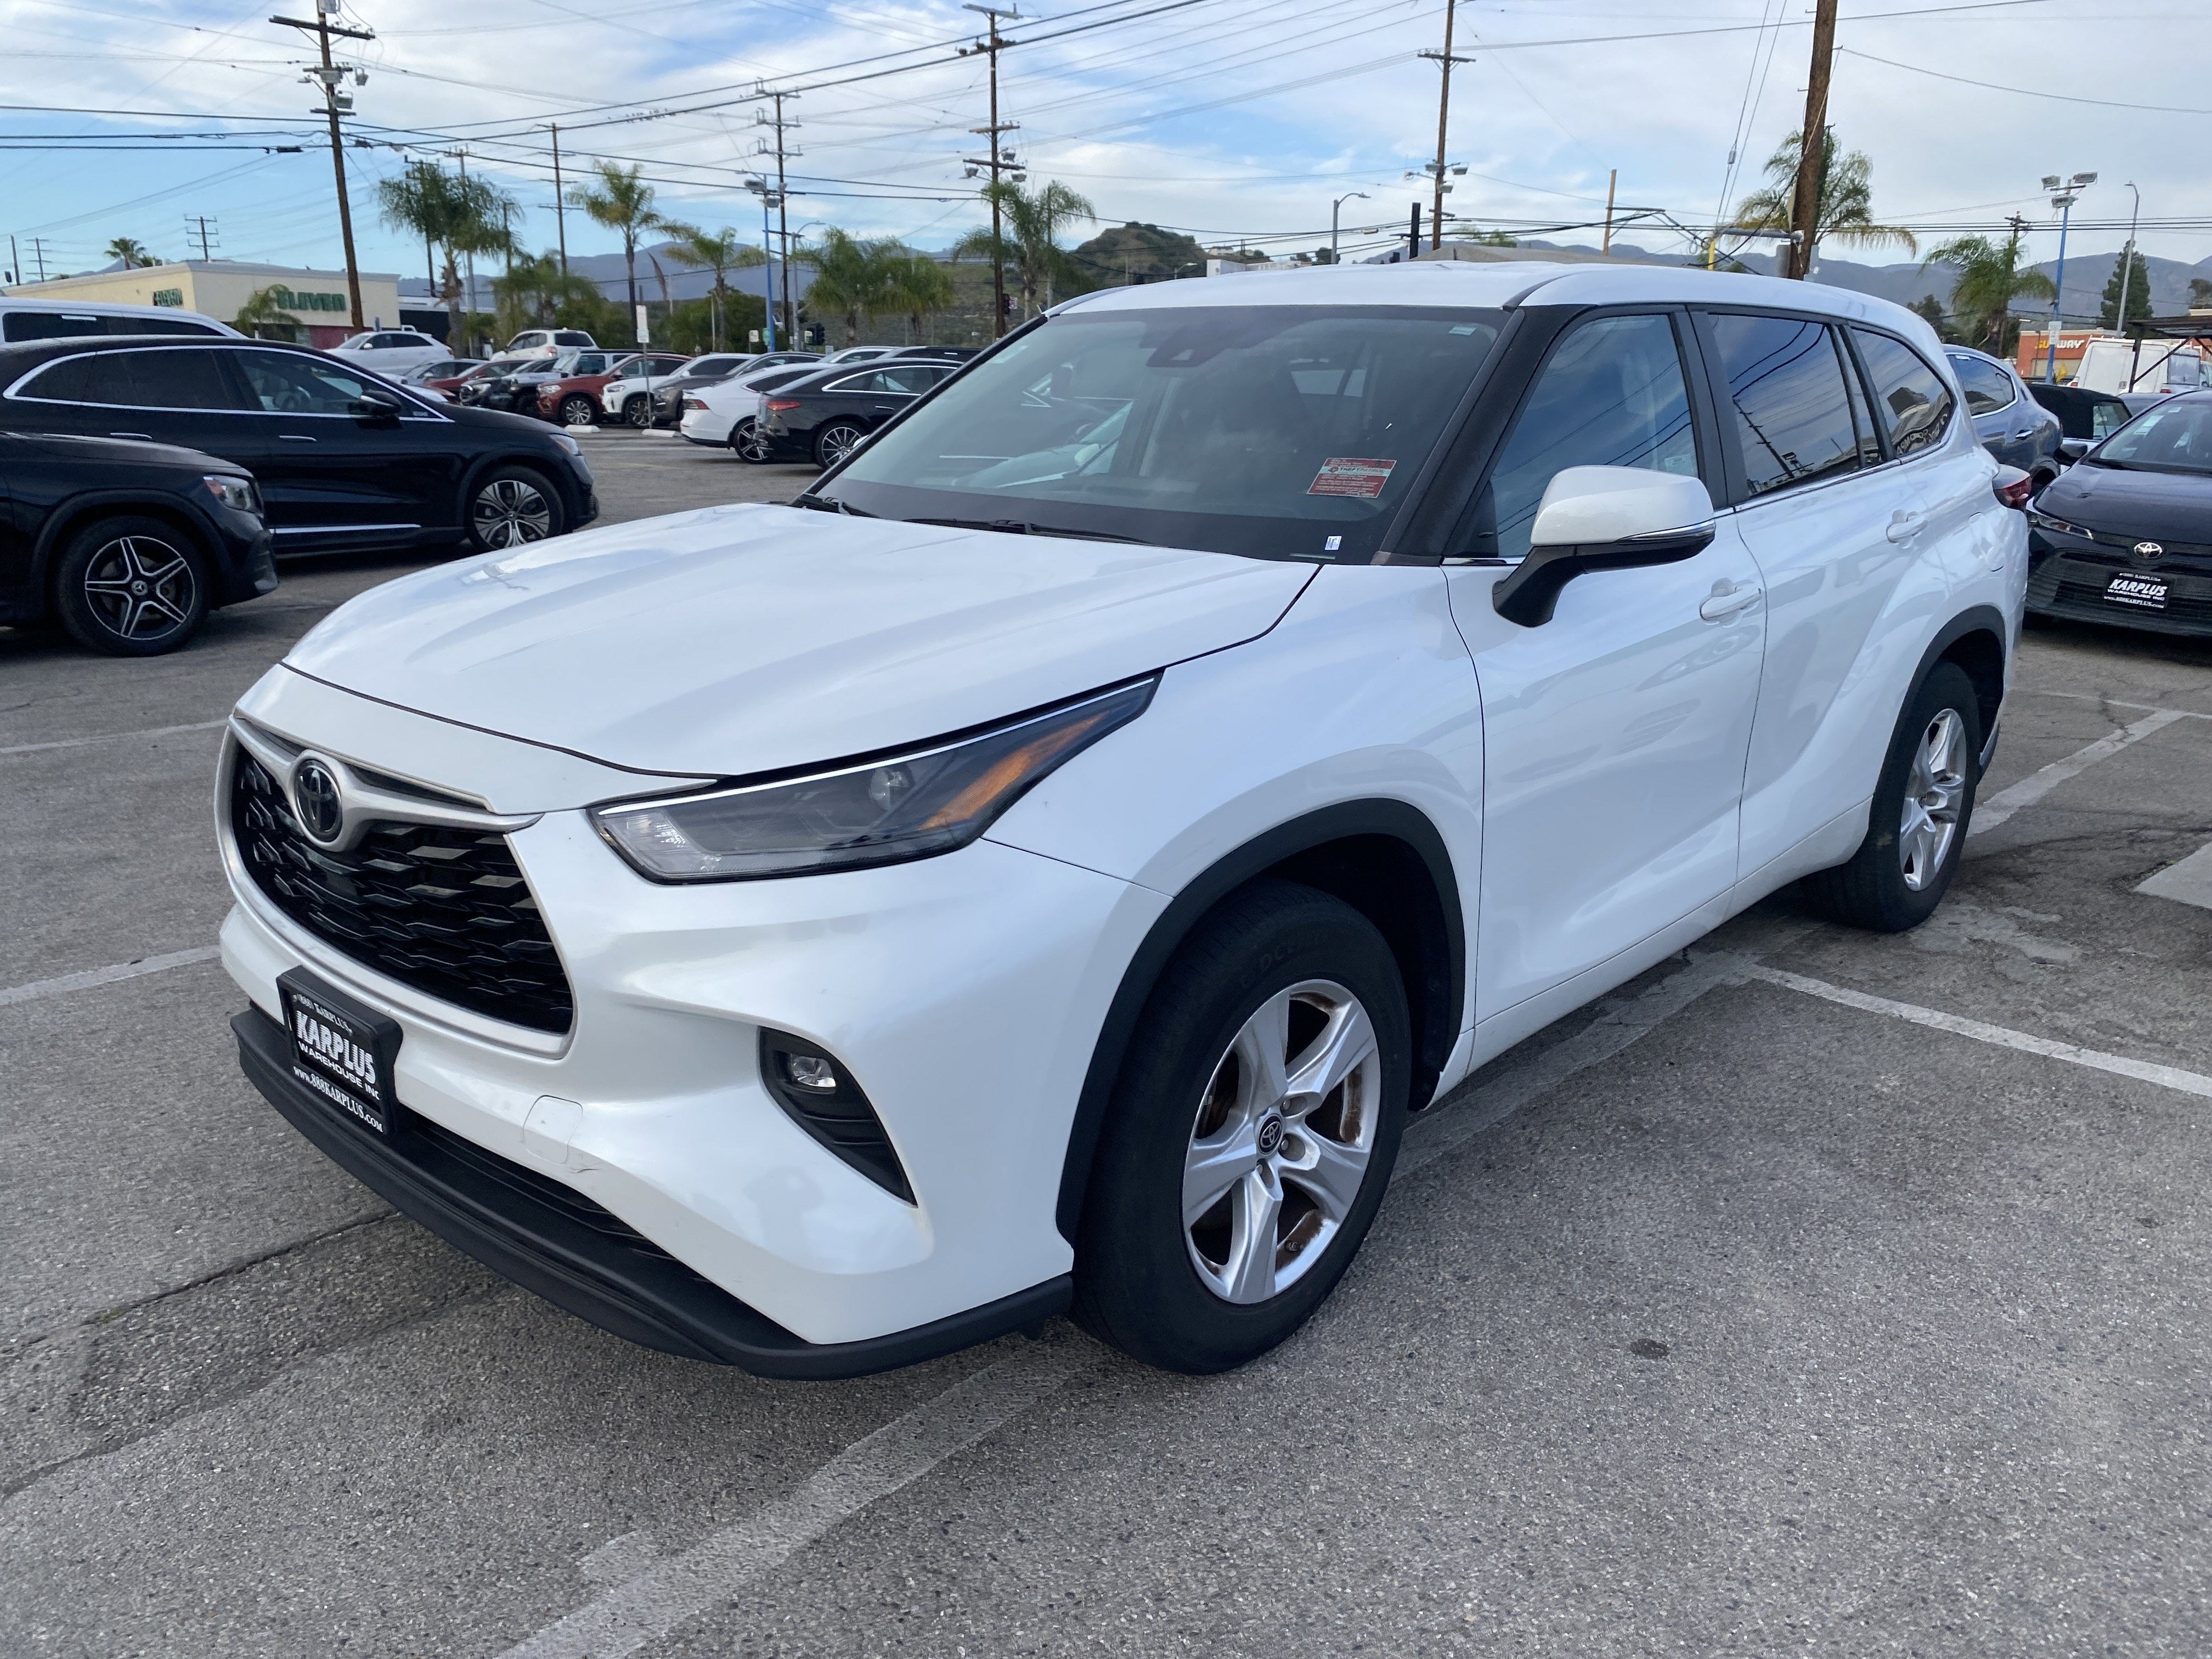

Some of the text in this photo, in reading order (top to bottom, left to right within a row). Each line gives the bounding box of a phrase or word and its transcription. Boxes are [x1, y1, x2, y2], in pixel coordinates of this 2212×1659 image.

[2035, 340, 2085, 348] SUWAY
[2107, 589, 2151, 599] WAREHOUSE
[2109, 579, 2168, 596] KARPLUS
[296, 1010, 376, 1084] KARPLUS
[298, 1041, 363, 1088] WAREHOUSE
